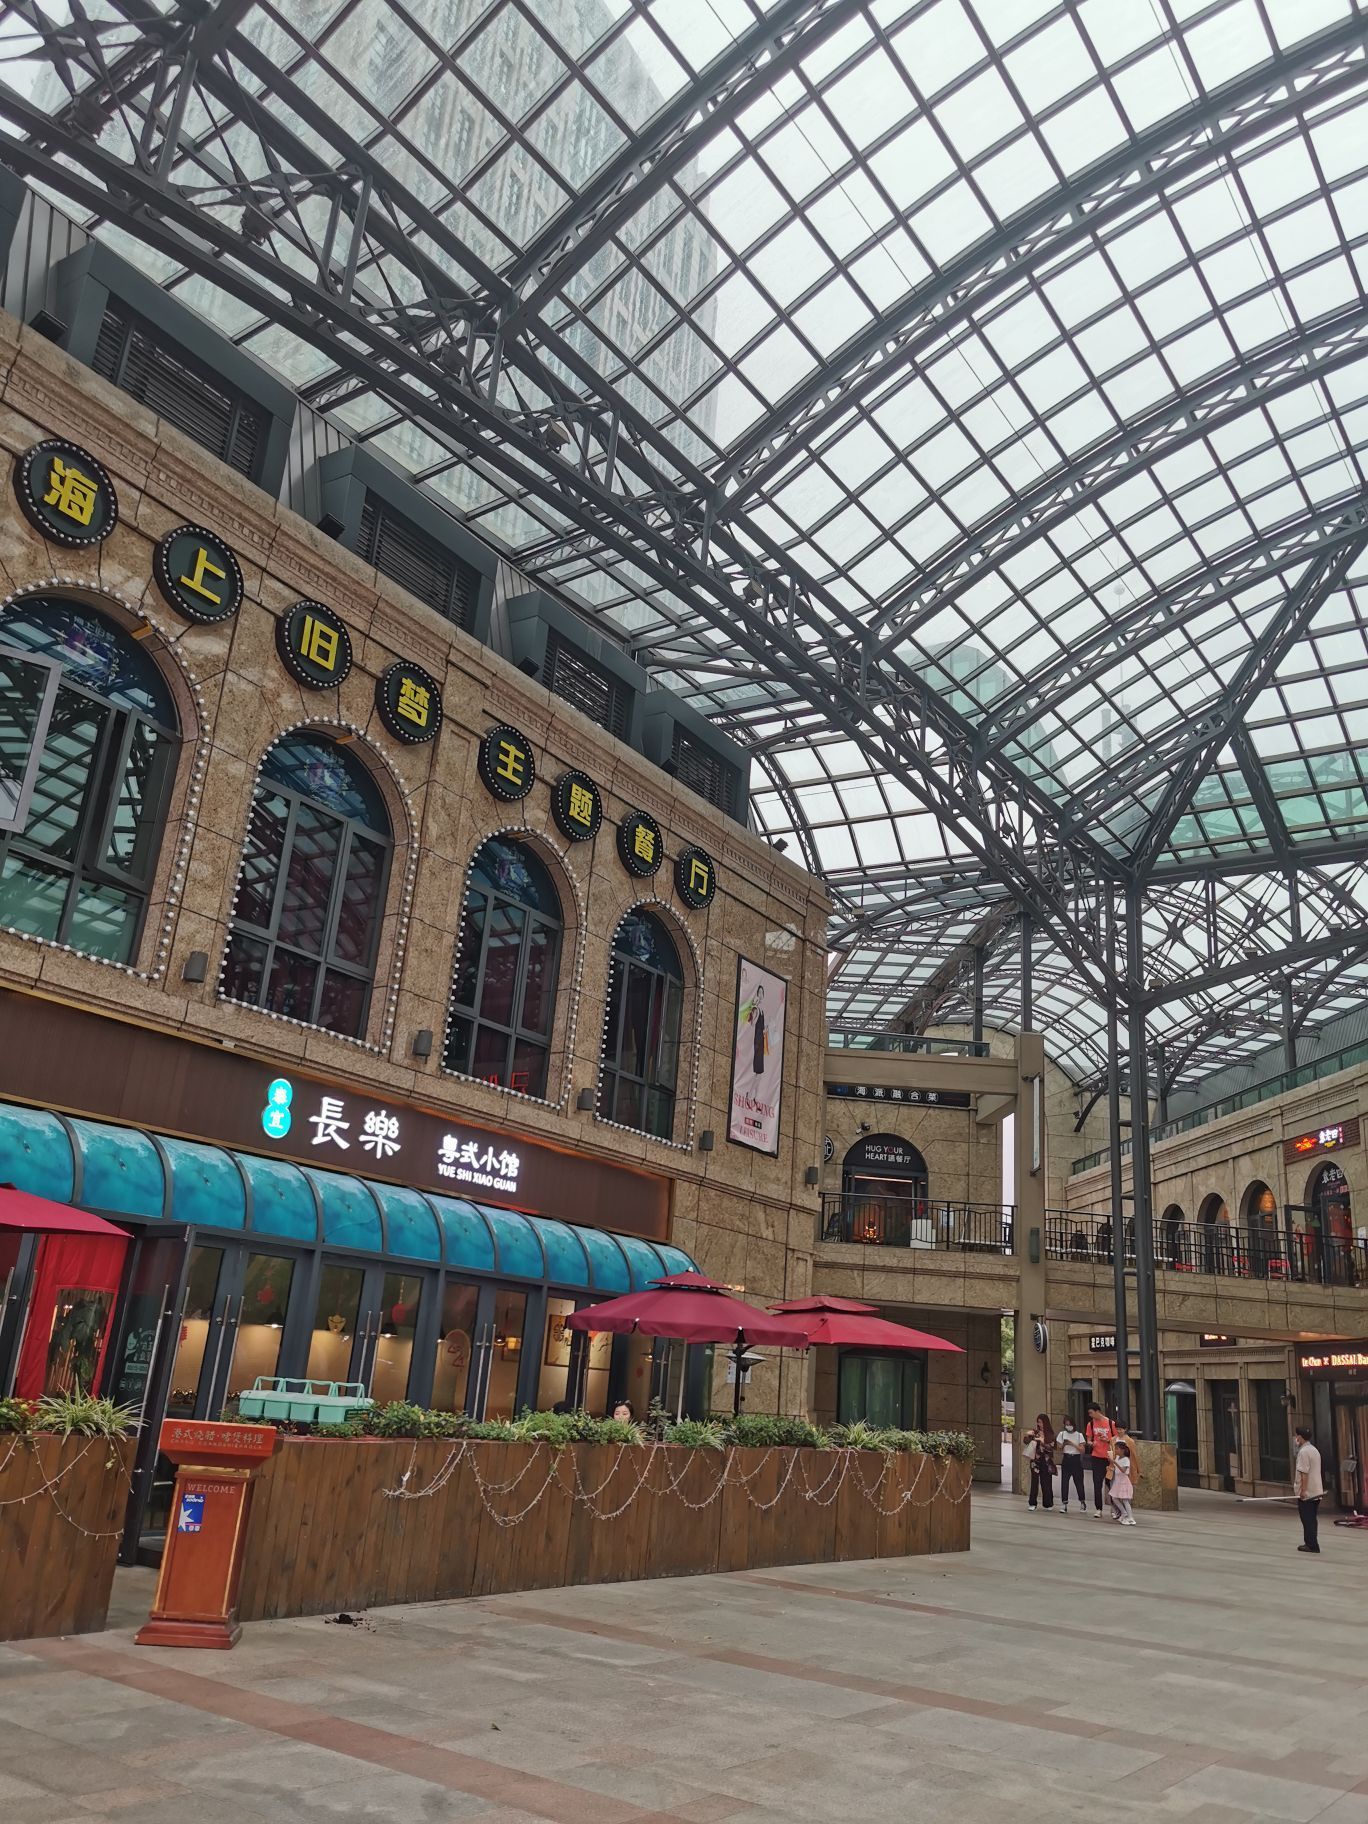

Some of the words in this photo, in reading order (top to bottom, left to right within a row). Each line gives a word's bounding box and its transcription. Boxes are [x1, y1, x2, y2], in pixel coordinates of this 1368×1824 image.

[857, 1086, 938, 1103] 海派融合菜
[734, 1093, 775, 1118] SHOPPING
[308, 1096, 402, 1160] 長樂
[437, 1134, 520, 1177] 粤式小馆
[865, 1145, 882, 1153] HUG
[883, 1146, 904, 1154] YOUR
[865, 1153, 887, 1161] HEART
[437, 1163, 456, 1178] YUE
[456, 1168, 472, 1181] SHI
[472, 1172, 493, 1187] XIAO
[493, 1177, 517, 1192] GUAN
[187, 1483, 235, 1494] WELCOME
